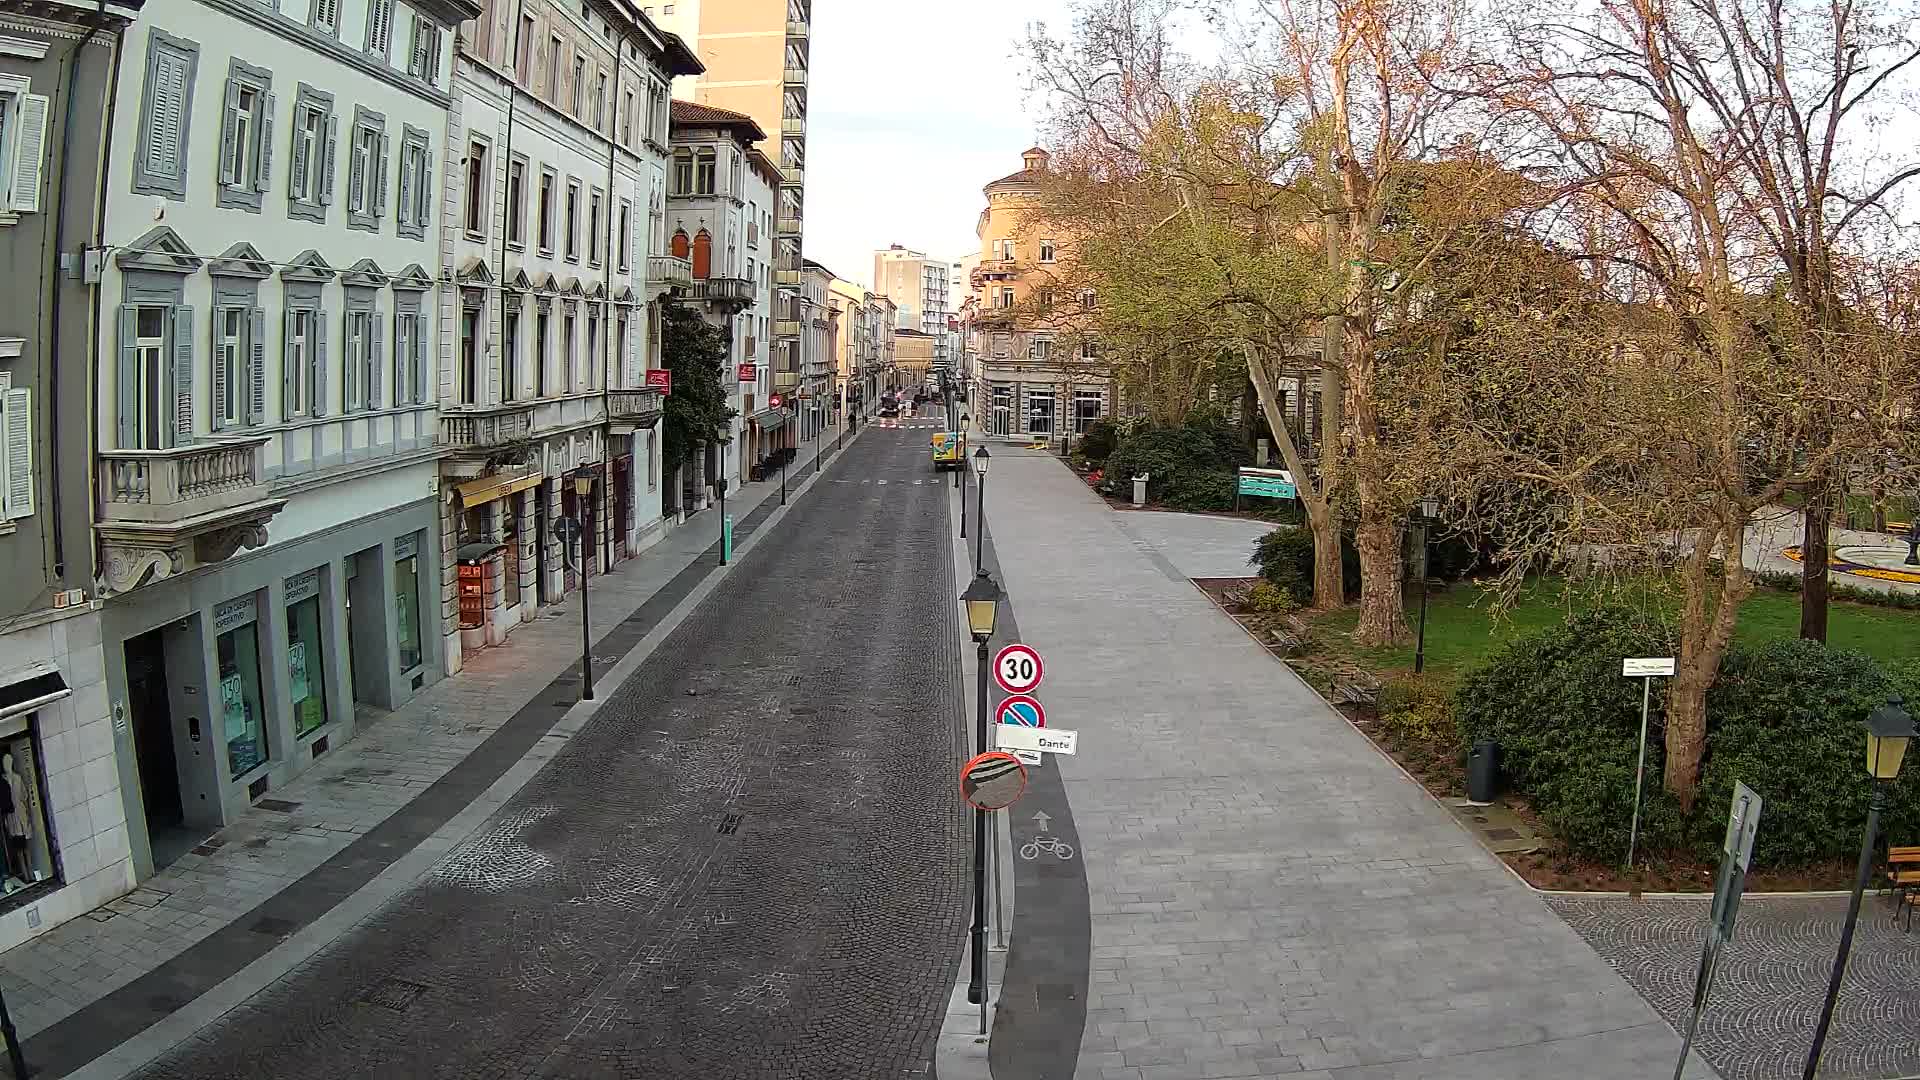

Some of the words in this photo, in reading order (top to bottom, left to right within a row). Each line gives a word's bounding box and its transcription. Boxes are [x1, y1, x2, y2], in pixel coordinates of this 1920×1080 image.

[1005, 658, 1033, 680] 30
[222, 677, 241, 701] 130
[1038, 738, 1070, 750] Dante
